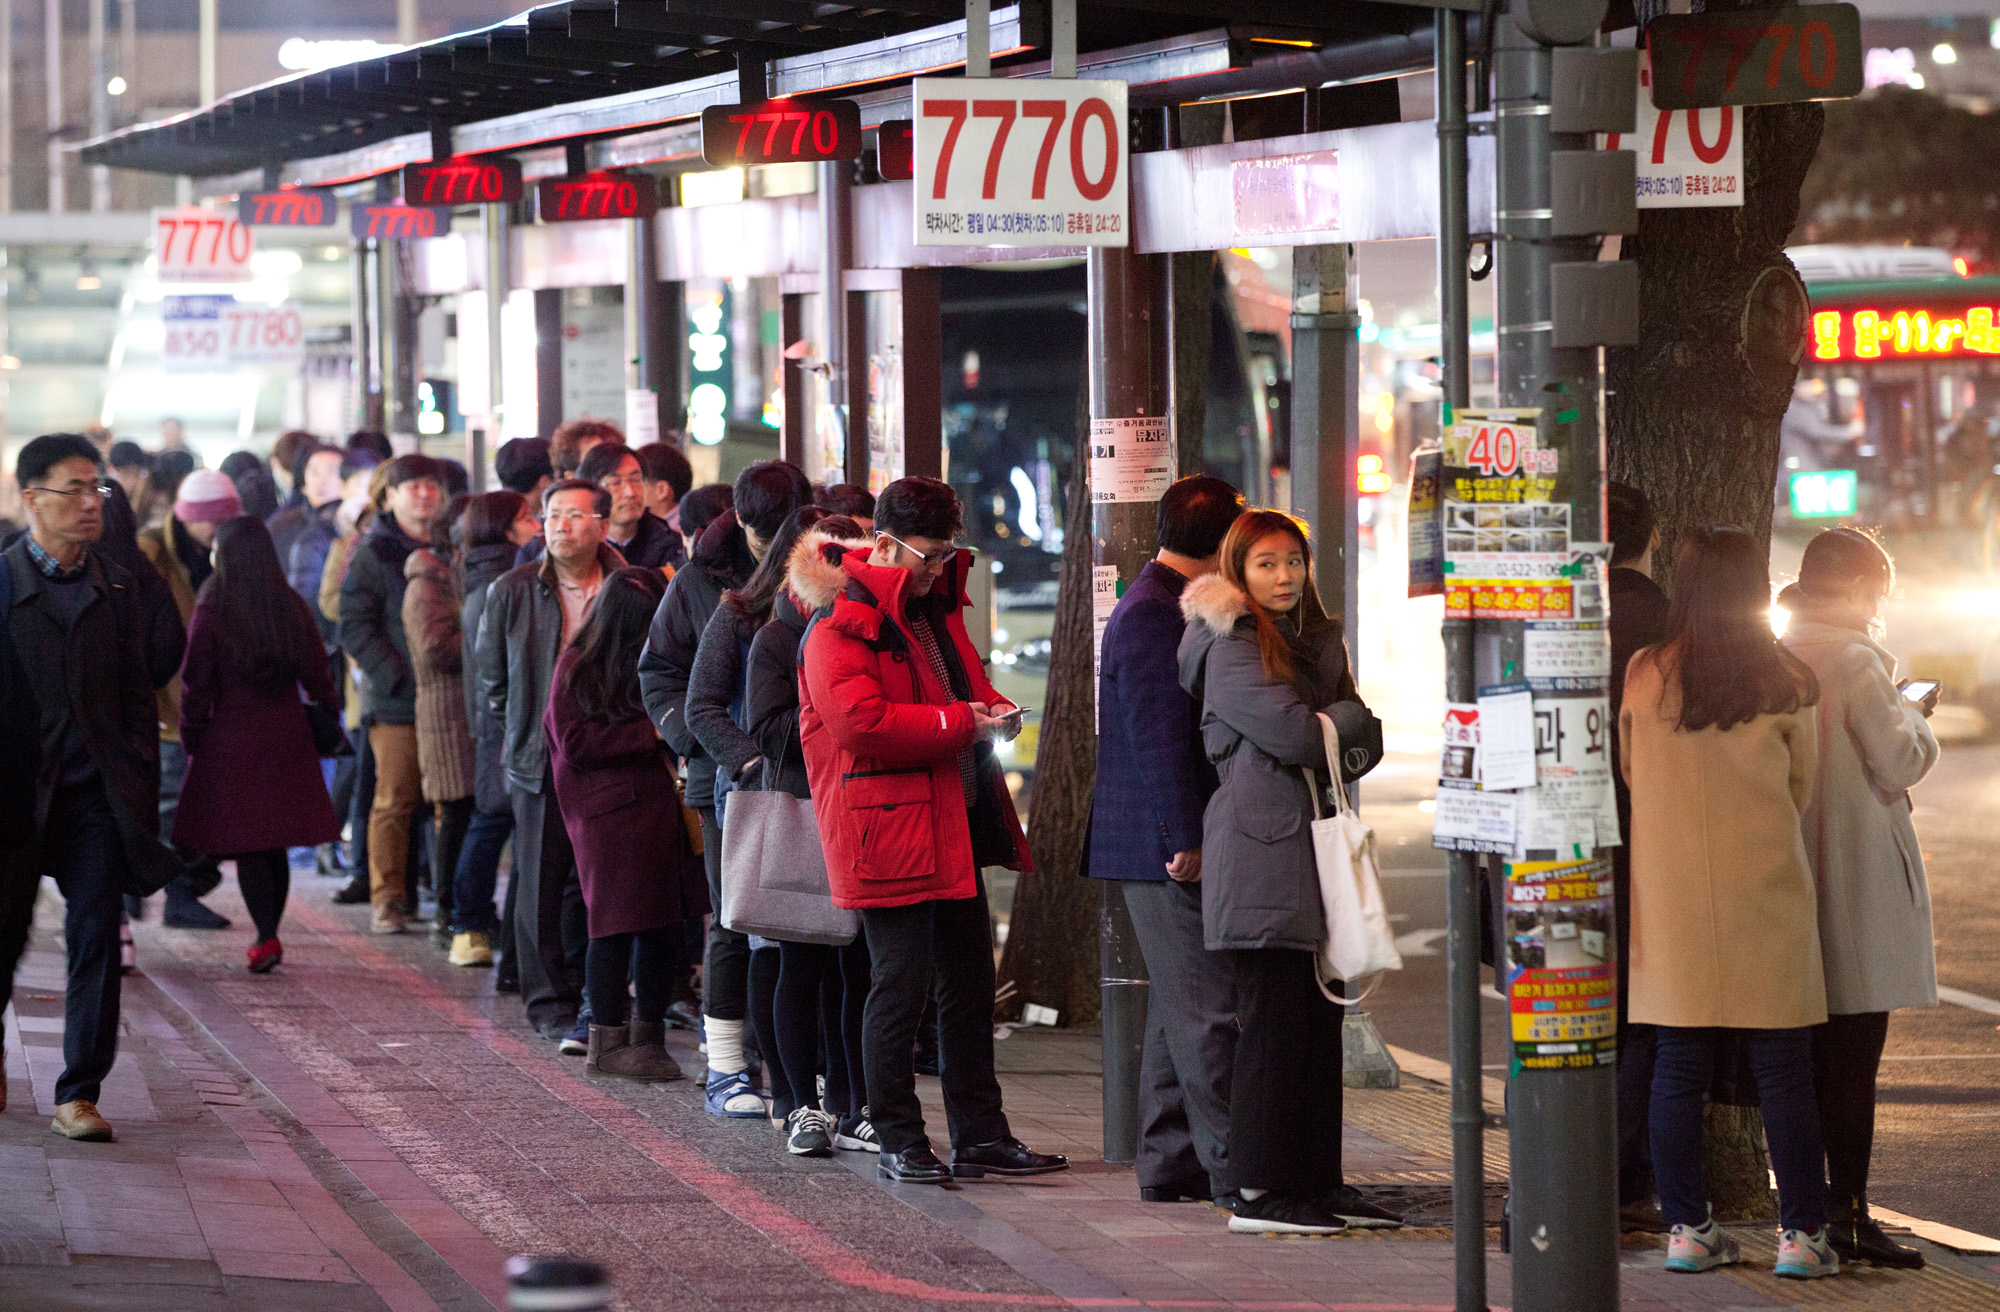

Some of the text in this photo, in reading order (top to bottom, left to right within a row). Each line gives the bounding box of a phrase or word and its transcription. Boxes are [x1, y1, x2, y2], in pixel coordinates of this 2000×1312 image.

[1672, 22, 1837, 95] 7770
[729, 110, 838, 157] 7770
[922, 97, 1119, 201] 7770
[418, 166, 503, 201] 7770
[553, 181, 637, 217] 7770
[1685, 175, 1710, 196] 공휴일
[1712, 175, 1737, 194] 24:20
[252, 194, 323, 226] 7770
[365, 206, 436, 238] 7770
[926, 213, 964, 234] 막차시간:
[967, 213, 984, 234] 평일
[1067, 213, 1093, 235] 공휴일
[1095, 213, 1121, 233] 24:20
[158, 219, 250, 264] 7770
